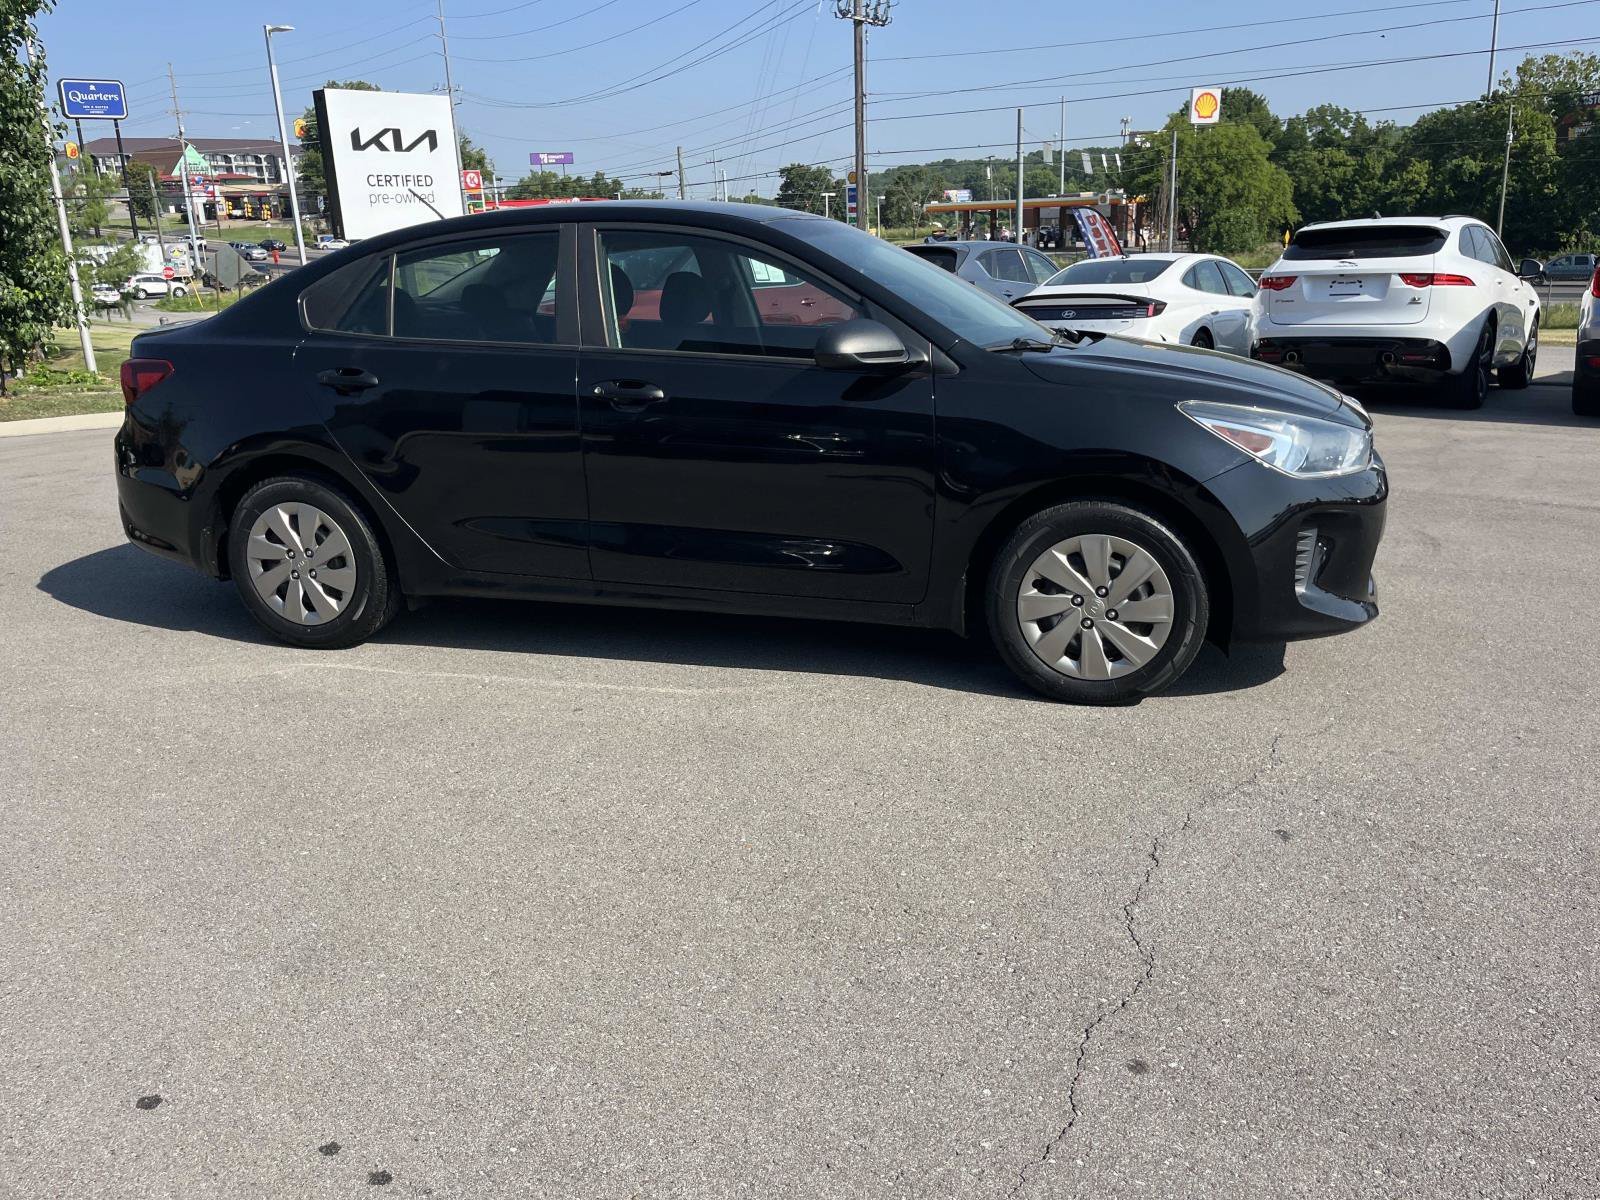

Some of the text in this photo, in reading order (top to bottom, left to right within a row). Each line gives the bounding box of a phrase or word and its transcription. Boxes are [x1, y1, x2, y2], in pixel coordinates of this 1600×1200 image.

[68, 90, 119, 104] Quarters
[350, 127, 438, 153] KIA
[366, 174, 434, 188] CERTIFIED
[369, 190, 435, 208] pre-owned
